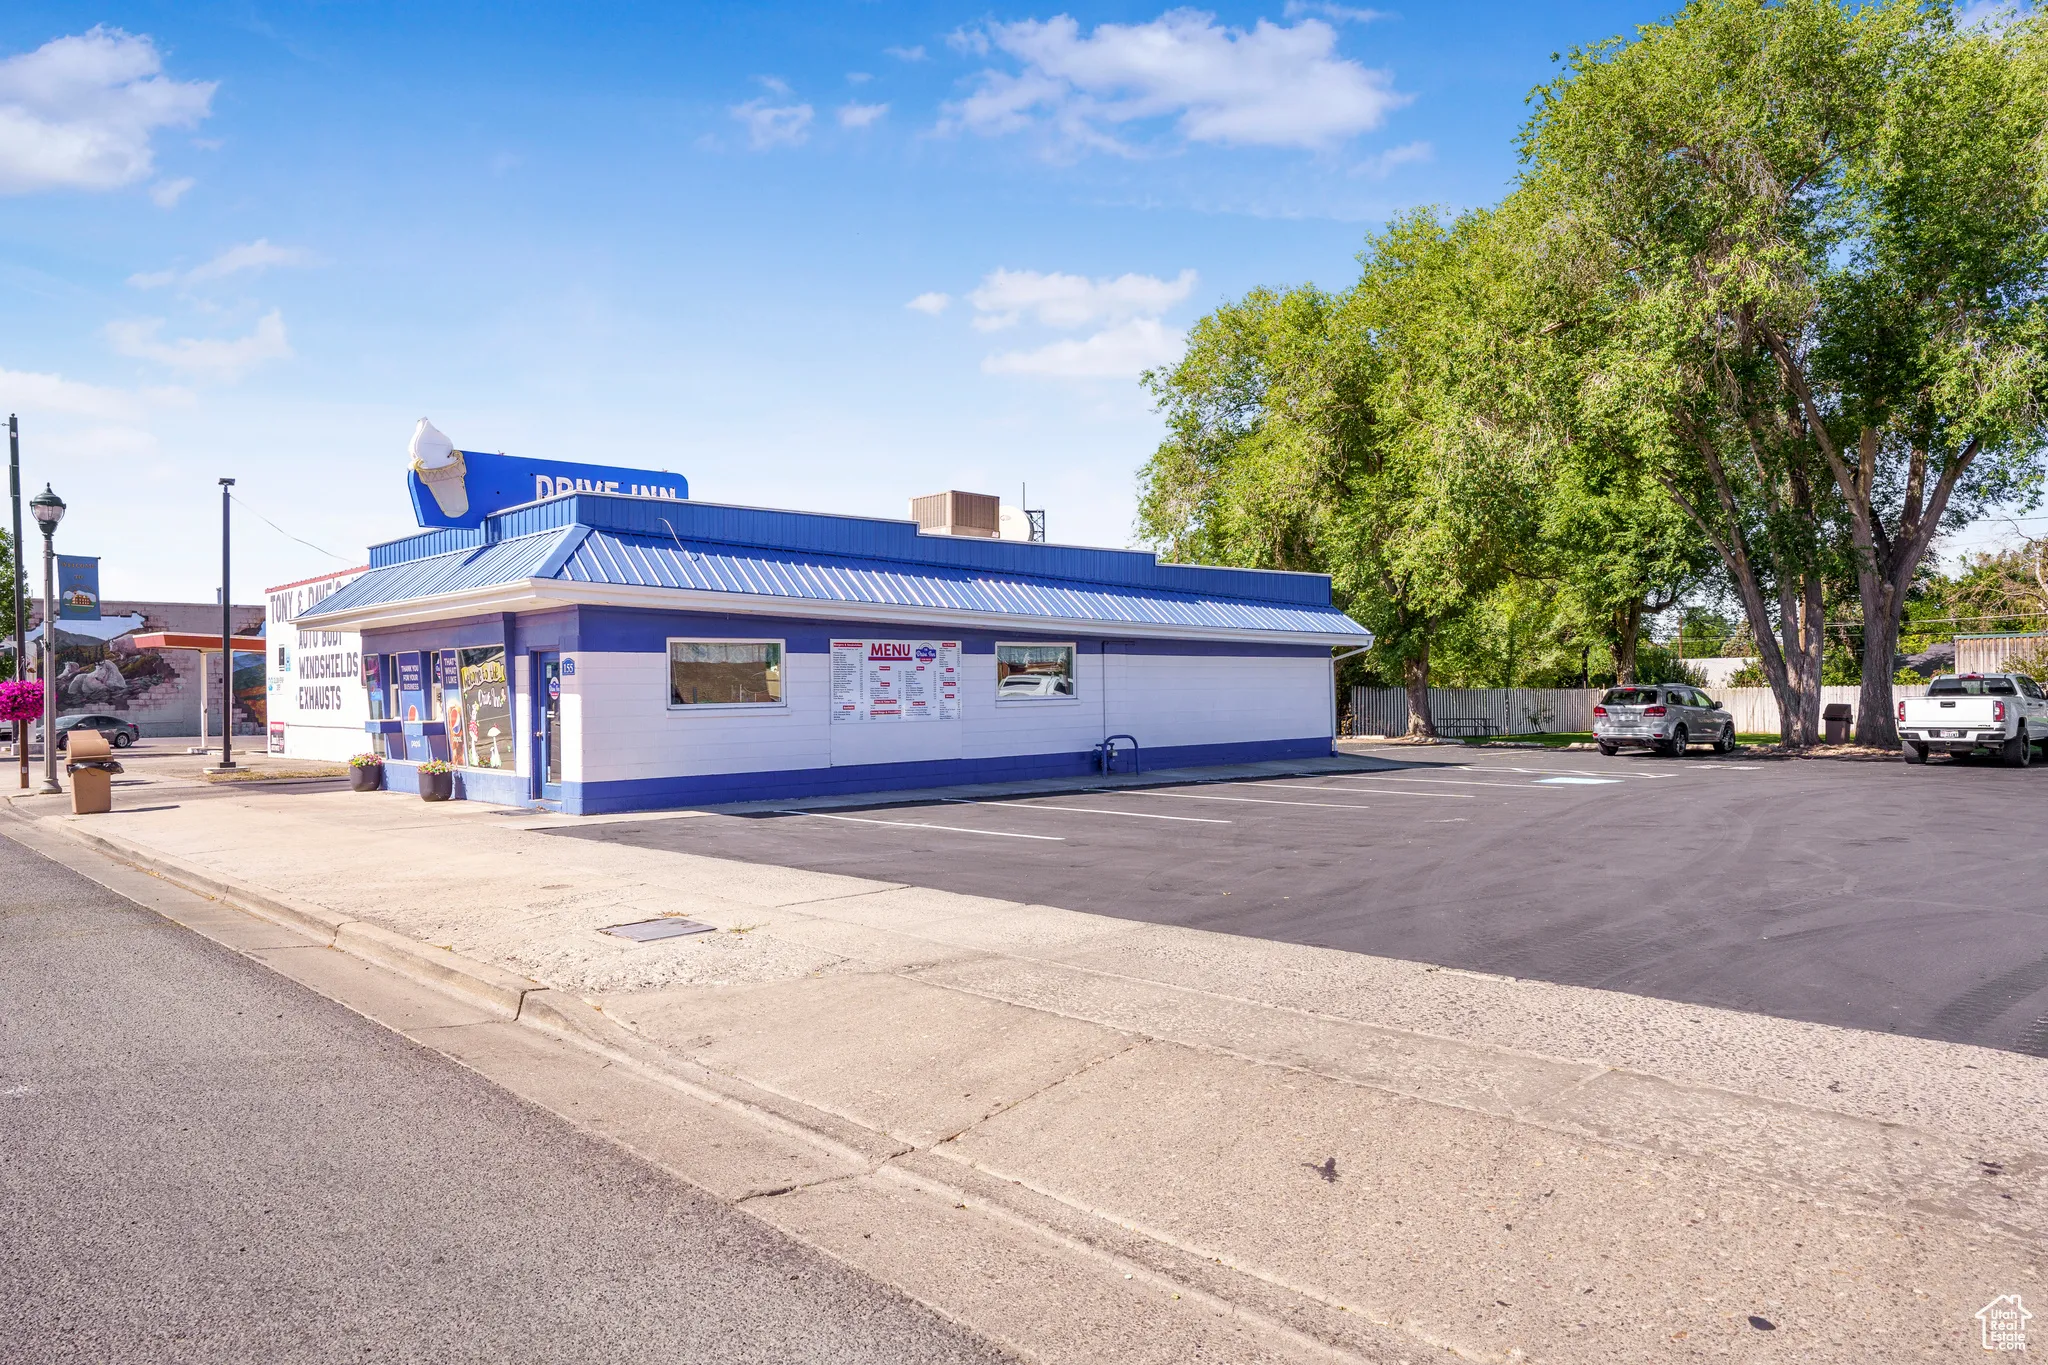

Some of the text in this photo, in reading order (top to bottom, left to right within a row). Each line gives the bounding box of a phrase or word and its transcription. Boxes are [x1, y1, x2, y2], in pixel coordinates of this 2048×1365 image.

[270, 591, 293, 624] TONY
[871, 643, 911, 657] MENU
[299, 652, 359, 680] WINDSHIELDS
[563, 663, 574, 673] 155
[299, 686, 341, 710] EXHAUSTS
